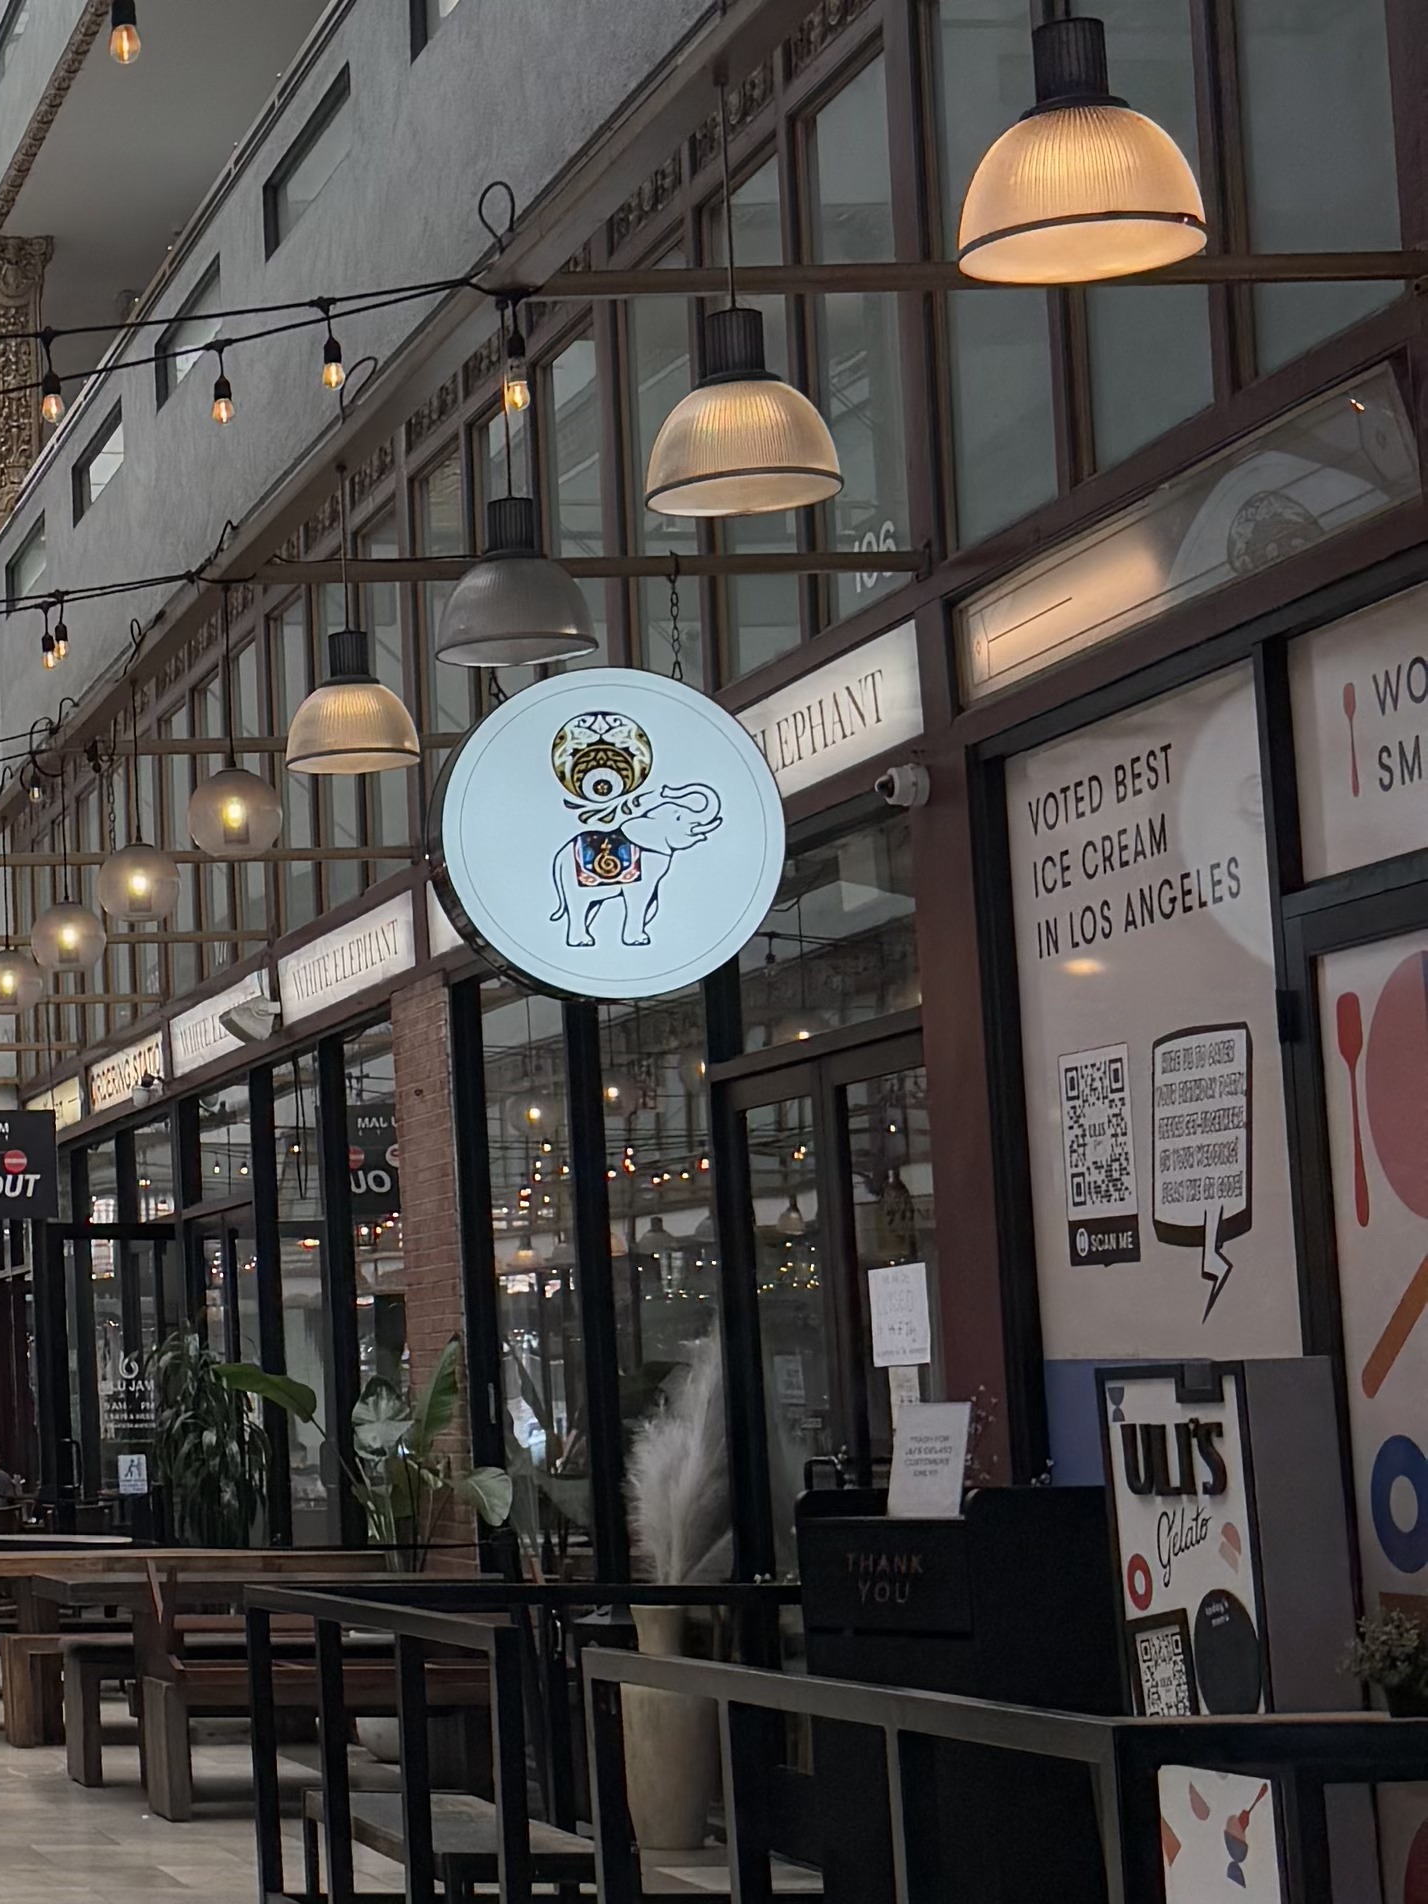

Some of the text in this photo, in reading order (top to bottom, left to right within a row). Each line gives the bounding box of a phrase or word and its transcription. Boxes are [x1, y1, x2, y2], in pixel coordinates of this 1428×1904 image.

[853, 519, 897, 593] 106
[1028, 743, 1172, 837] VOTED BEST
[1033, 813, 1168, 898] ICE CREAM
[1037, 856, 1241, 959] IN LOS ANGELES
[292, 952, 332, 1002] WHITE
[333, 918, 399, 987] ELEPHANT
[1090, 1231, 1134, 1252] SCAN ME
[1120, 1417, 1228, 1496] ULI'S
[846, 1553, 923, 1576] THANK
[1156, 1505, 1212, 1588] Gelato
[858, 1580, 910, 1606] YOU
